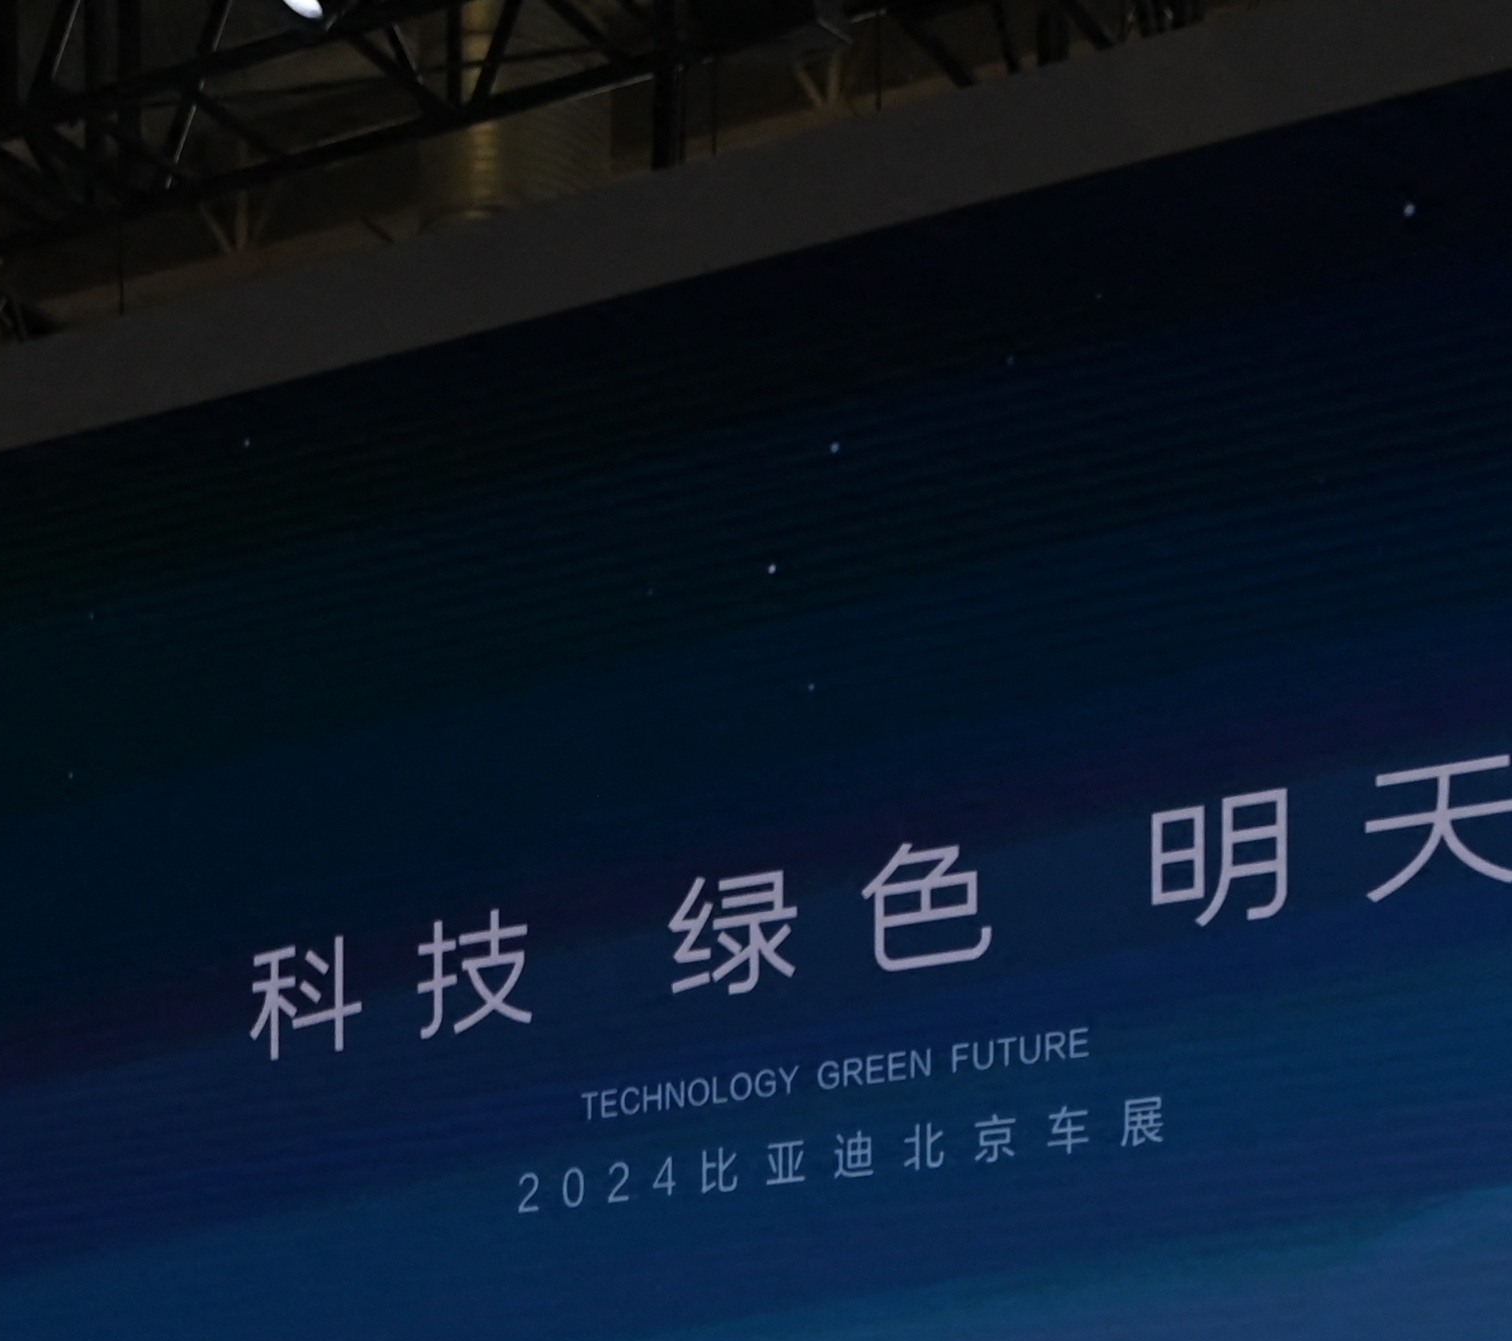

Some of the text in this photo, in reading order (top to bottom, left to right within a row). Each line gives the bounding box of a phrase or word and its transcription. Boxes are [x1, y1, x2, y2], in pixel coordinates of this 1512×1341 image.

[248, 908, 533, 1061] 科技
[667, 842, 992, 995] 绿色
[581, 1027, 1089, 1120] TECHNOLOGY GREEN FUTURE
